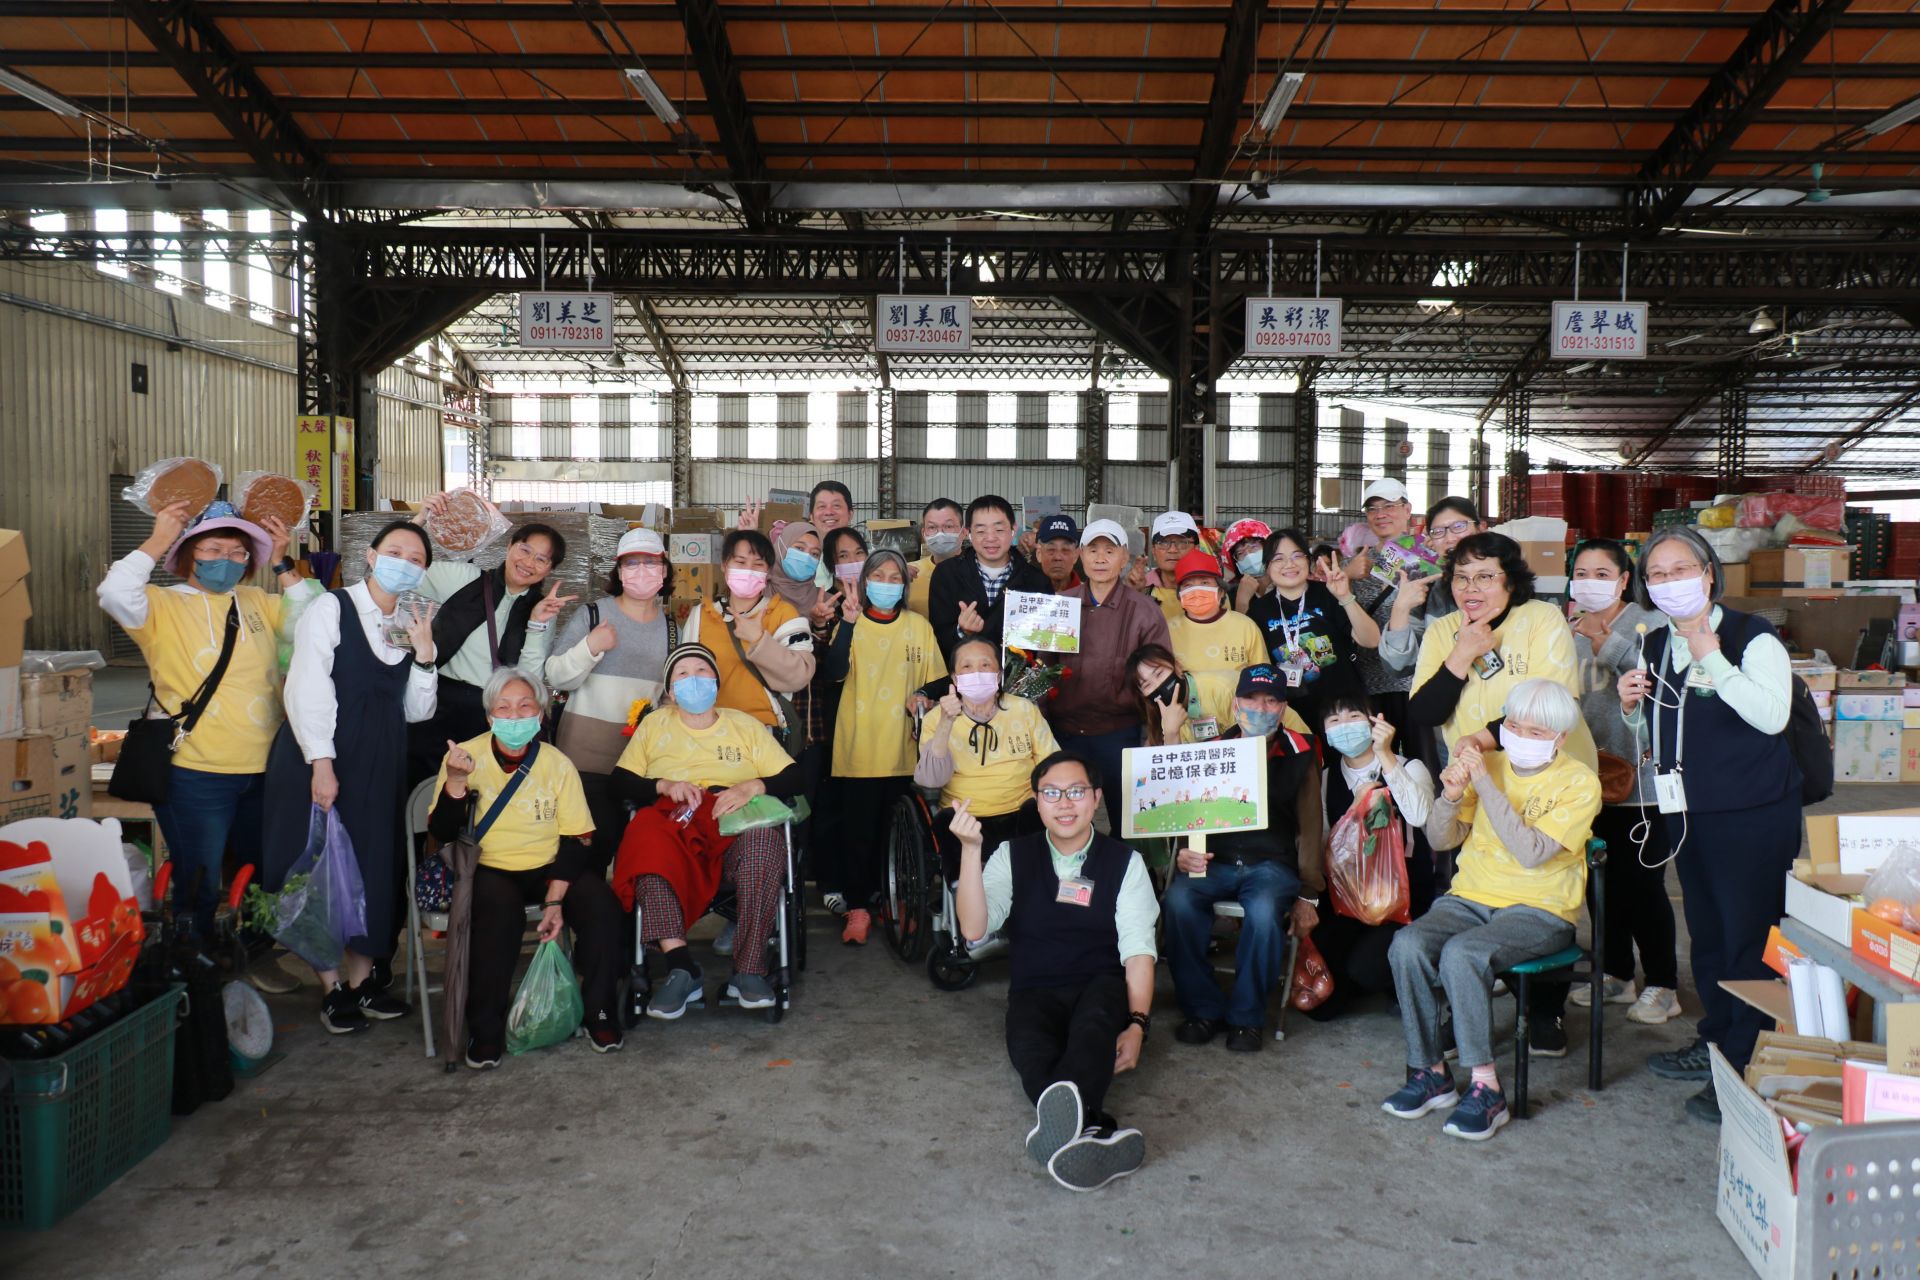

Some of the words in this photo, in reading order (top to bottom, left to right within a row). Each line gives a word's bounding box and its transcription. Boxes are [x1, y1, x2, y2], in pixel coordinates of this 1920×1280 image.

[532, 300, 601, 325] 劉美芝
[889, 303, 960, 328] 劉美鳳
[1258, 306, 1330, 331] 吳彩潔
[1565, 309, 1637, 334] 詹翠娥
[530, 326, 603, 340] 0911-792318
[886, 328, 963, 343] 0937-230467
[1256, 331, 1331, 346] 0928-974703
[1561, 336, 1636, 350] 0921-331513
[1151, 746, 1236, 764] 台中慈濟醫院
[1150, 761, 1237, 781] 記憶保養班
